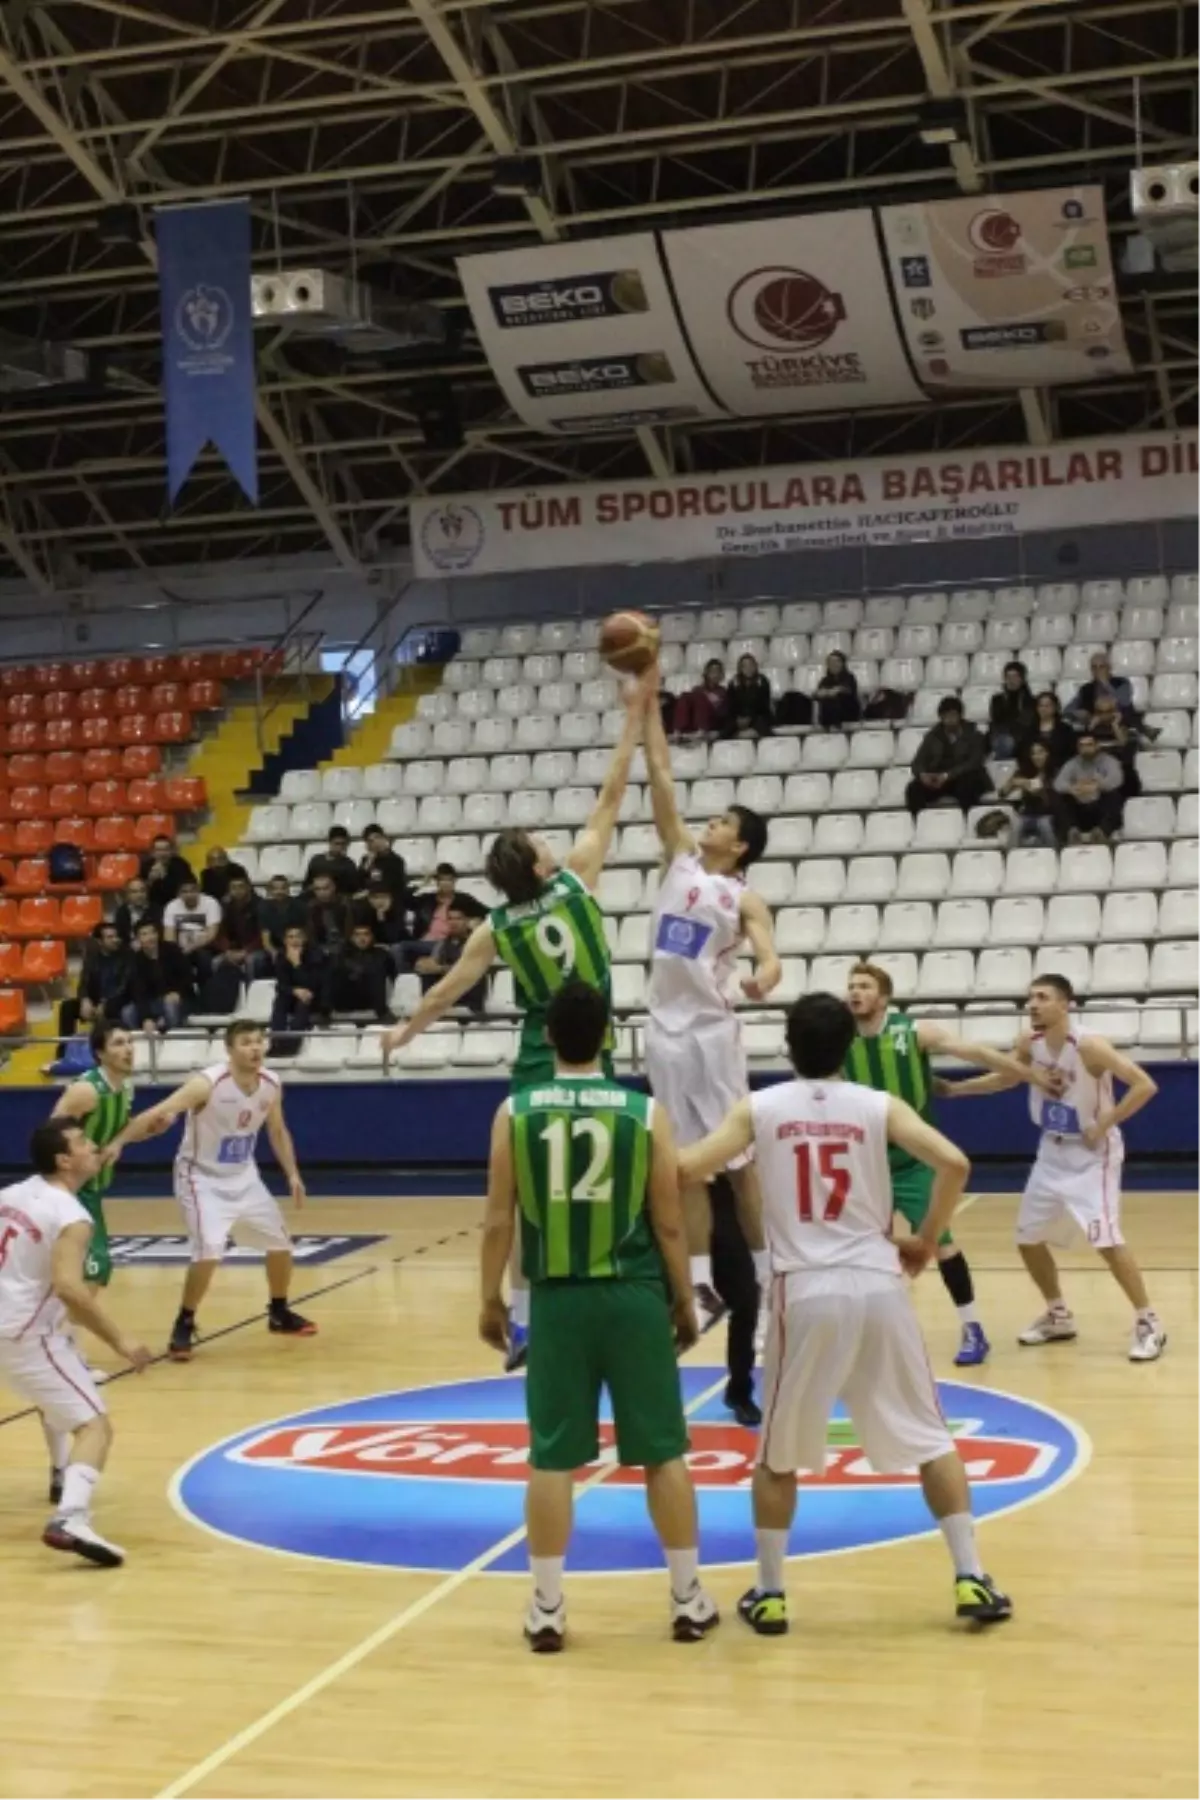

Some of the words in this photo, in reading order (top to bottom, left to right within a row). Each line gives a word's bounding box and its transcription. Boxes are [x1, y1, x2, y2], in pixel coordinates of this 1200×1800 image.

[500, 285, 603, 315] BEKO
[495, 491, 582, 532] TÜM
[594, 472, 867, 524] SPORCULARA
[881, 448, 1123, 504] BAŞARILAR
[536, 915, 576, 978] 9
[539, 1117, 614, 1200] 12
[793, 1142, 852, 1222] 15
